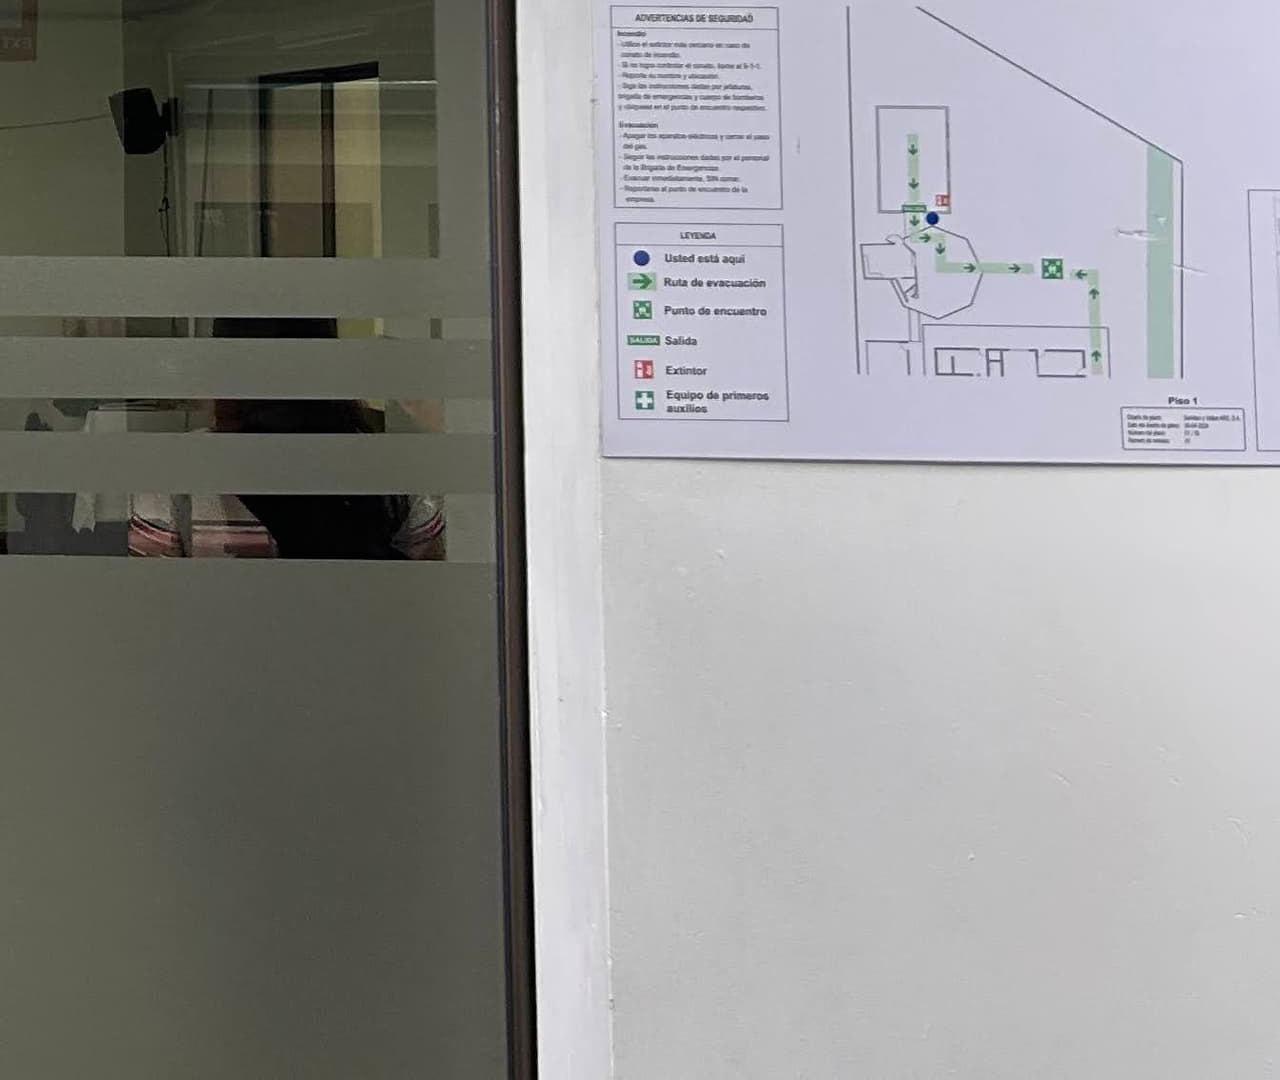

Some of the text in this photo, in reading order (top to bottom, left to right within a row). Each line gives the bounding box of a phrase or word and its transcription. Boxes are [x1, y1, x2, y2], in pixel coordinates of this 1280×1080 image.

[664, 253, 696, 264] Usted
[697, 253, 720, 264] está
[663, 277, 689, 288] Ruta
[690, 277, 704, 288] de
[664, 305, 768, 317] Punto de encuentro
[664, 335, 698, 346] Salida
[665, 365, 708, 376] Extintor
[666, 389, 770, 402] Equipo de primeros
[1167, 396, 1198, 405] Piso 1
[666, 404, 708, 414] auxilios
